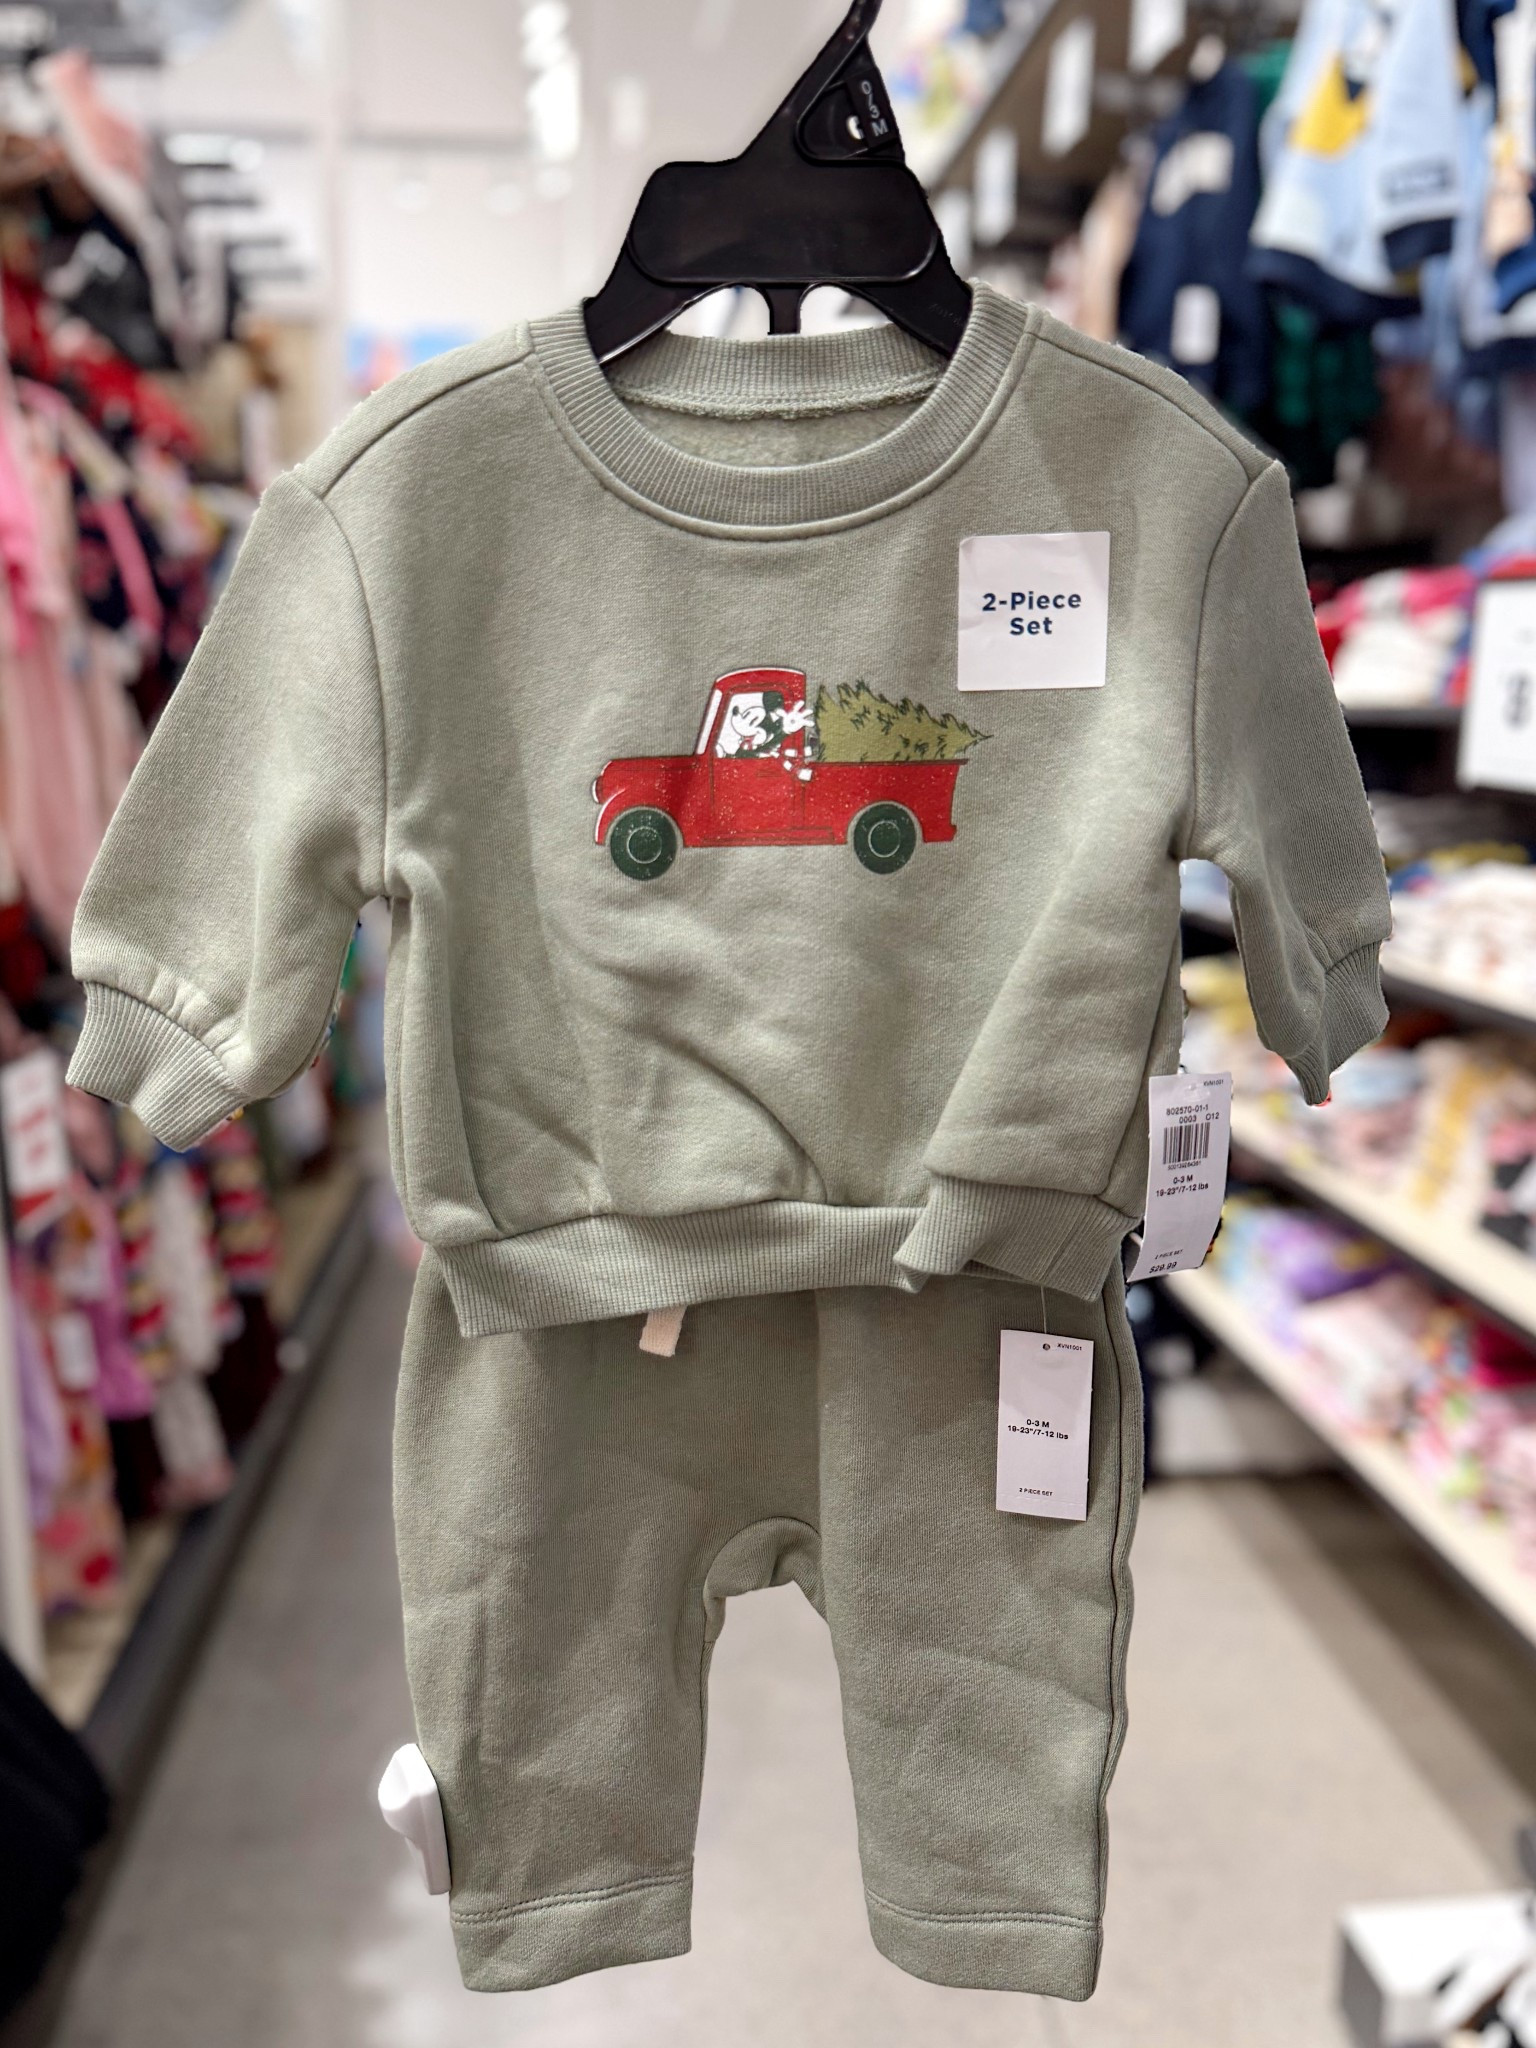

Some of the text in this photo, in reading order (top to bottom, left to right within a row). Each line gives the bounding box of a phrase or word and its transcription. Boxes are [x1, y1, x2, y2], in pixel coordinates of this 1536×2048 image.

[982, 591, 1082, 611] 2-Piece
[1009, 617, 1053, 635] Set
[1166, 1104, 1209, 1116] 802570-01-1
[1186, 1174, 1194, 1182] M
[1056, 1432, 1069, 1440] lbs
